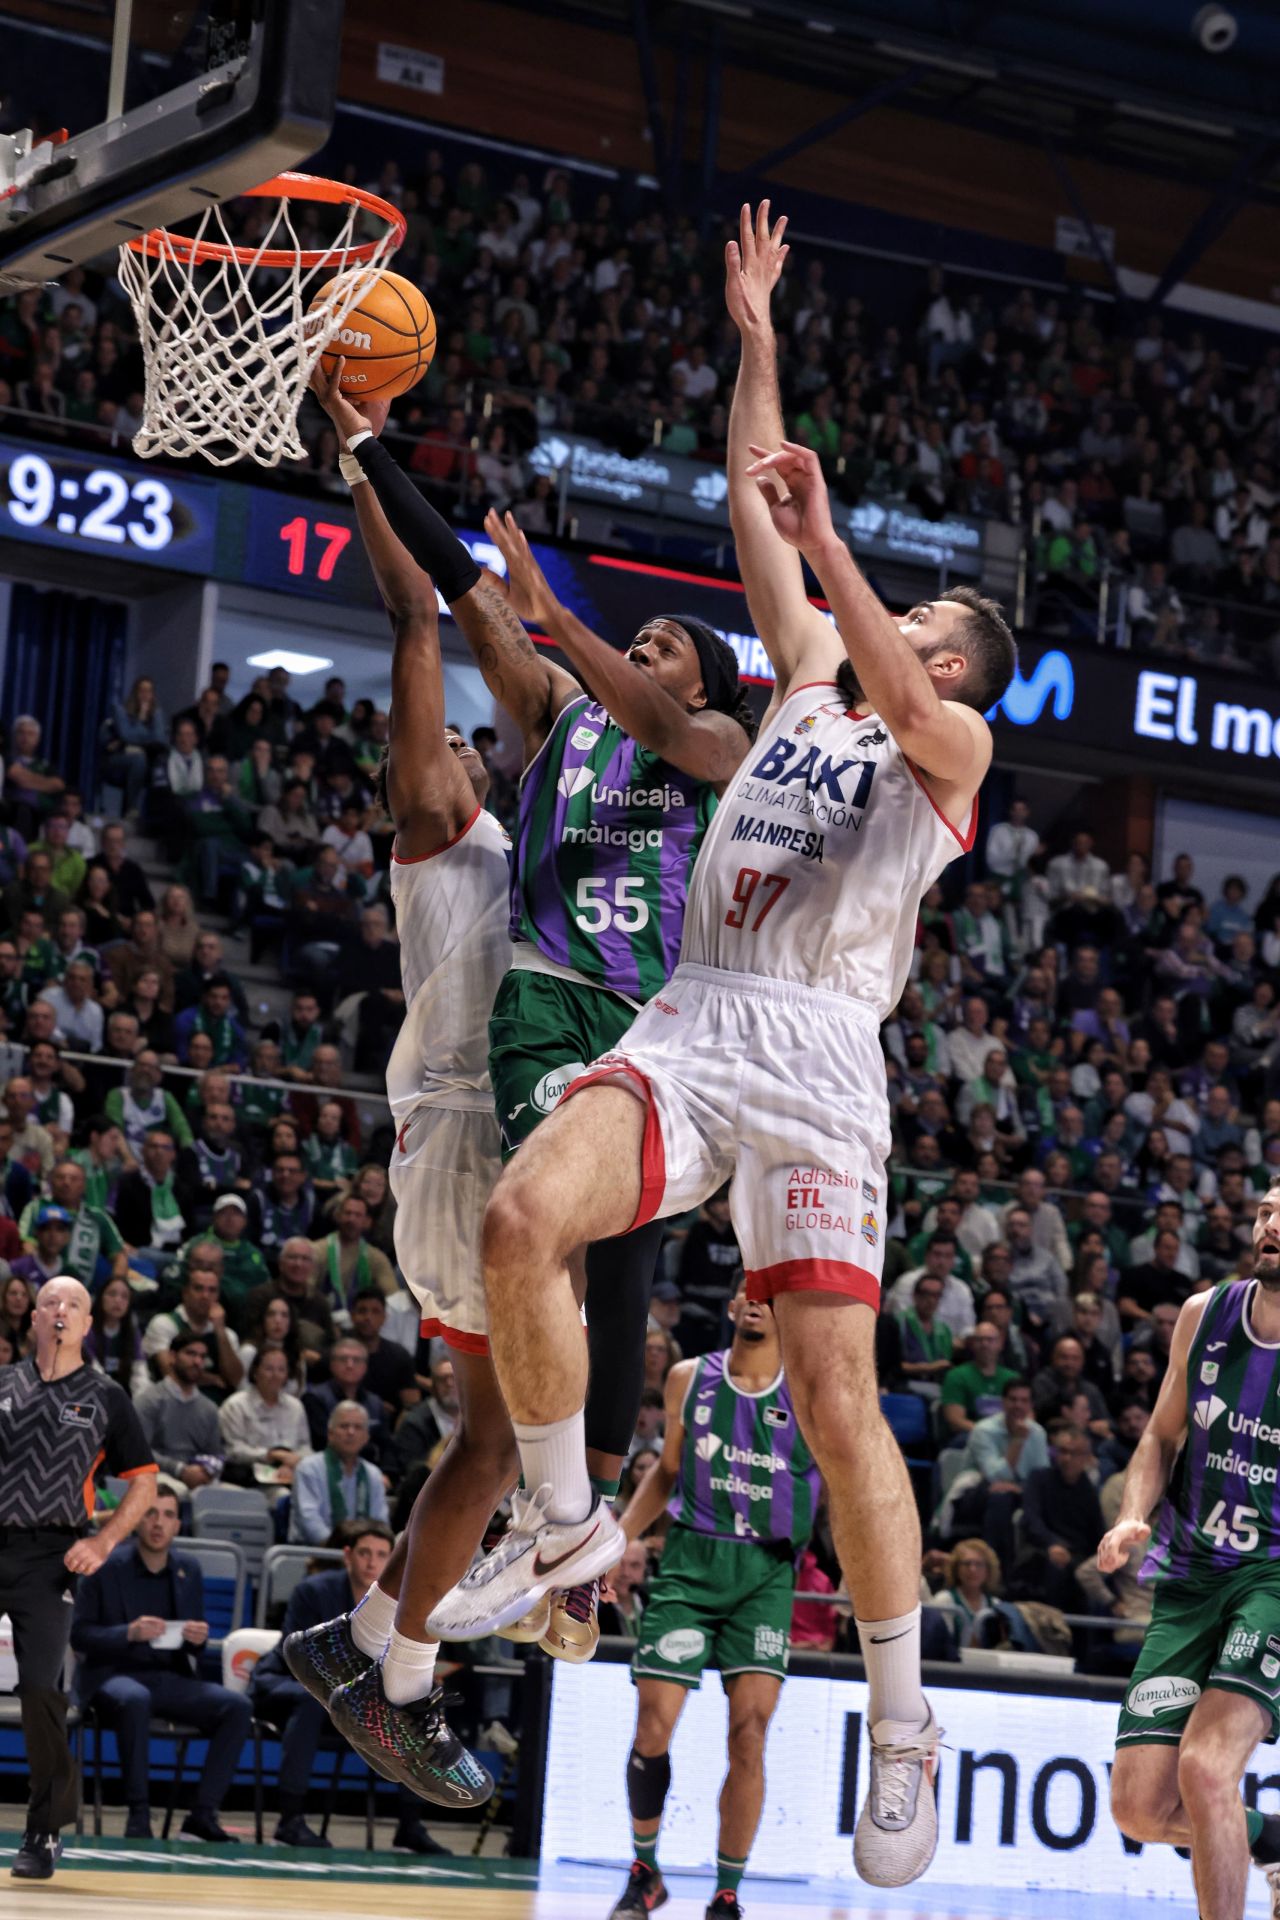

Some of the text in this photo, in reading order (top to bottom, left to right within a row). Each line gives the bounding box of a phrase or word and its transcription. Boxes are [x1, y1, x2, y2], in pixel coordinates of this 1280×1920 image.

[8, 453, 174, 551] 9:23
[279, 516, 351, 581] 17
[1134, 670, 1198, 745] El
[591, 783, 686, 812] Unicaja
[750, 736, 877, 810] BAXI
[737, 782, 863, 831] CLIMATIZACIÓN
[730, 814, 825, 864] MANRESA
[575, 876, 649, 933] 55
[724, 867, 791, 932] 97
[787, 1188, 824, 1209] ETL
[788, 1168, 858, 1190] Adbisio
[785, 1212, 855, 1236] GLOBAL
[1227, 1411, 1280, 1450] Unica
[722, 1444, 787, 1473] Unicaja
[1202, 1500, 1260, 1551] 45
[1131, 1680, 1198, 1710] famadesa
